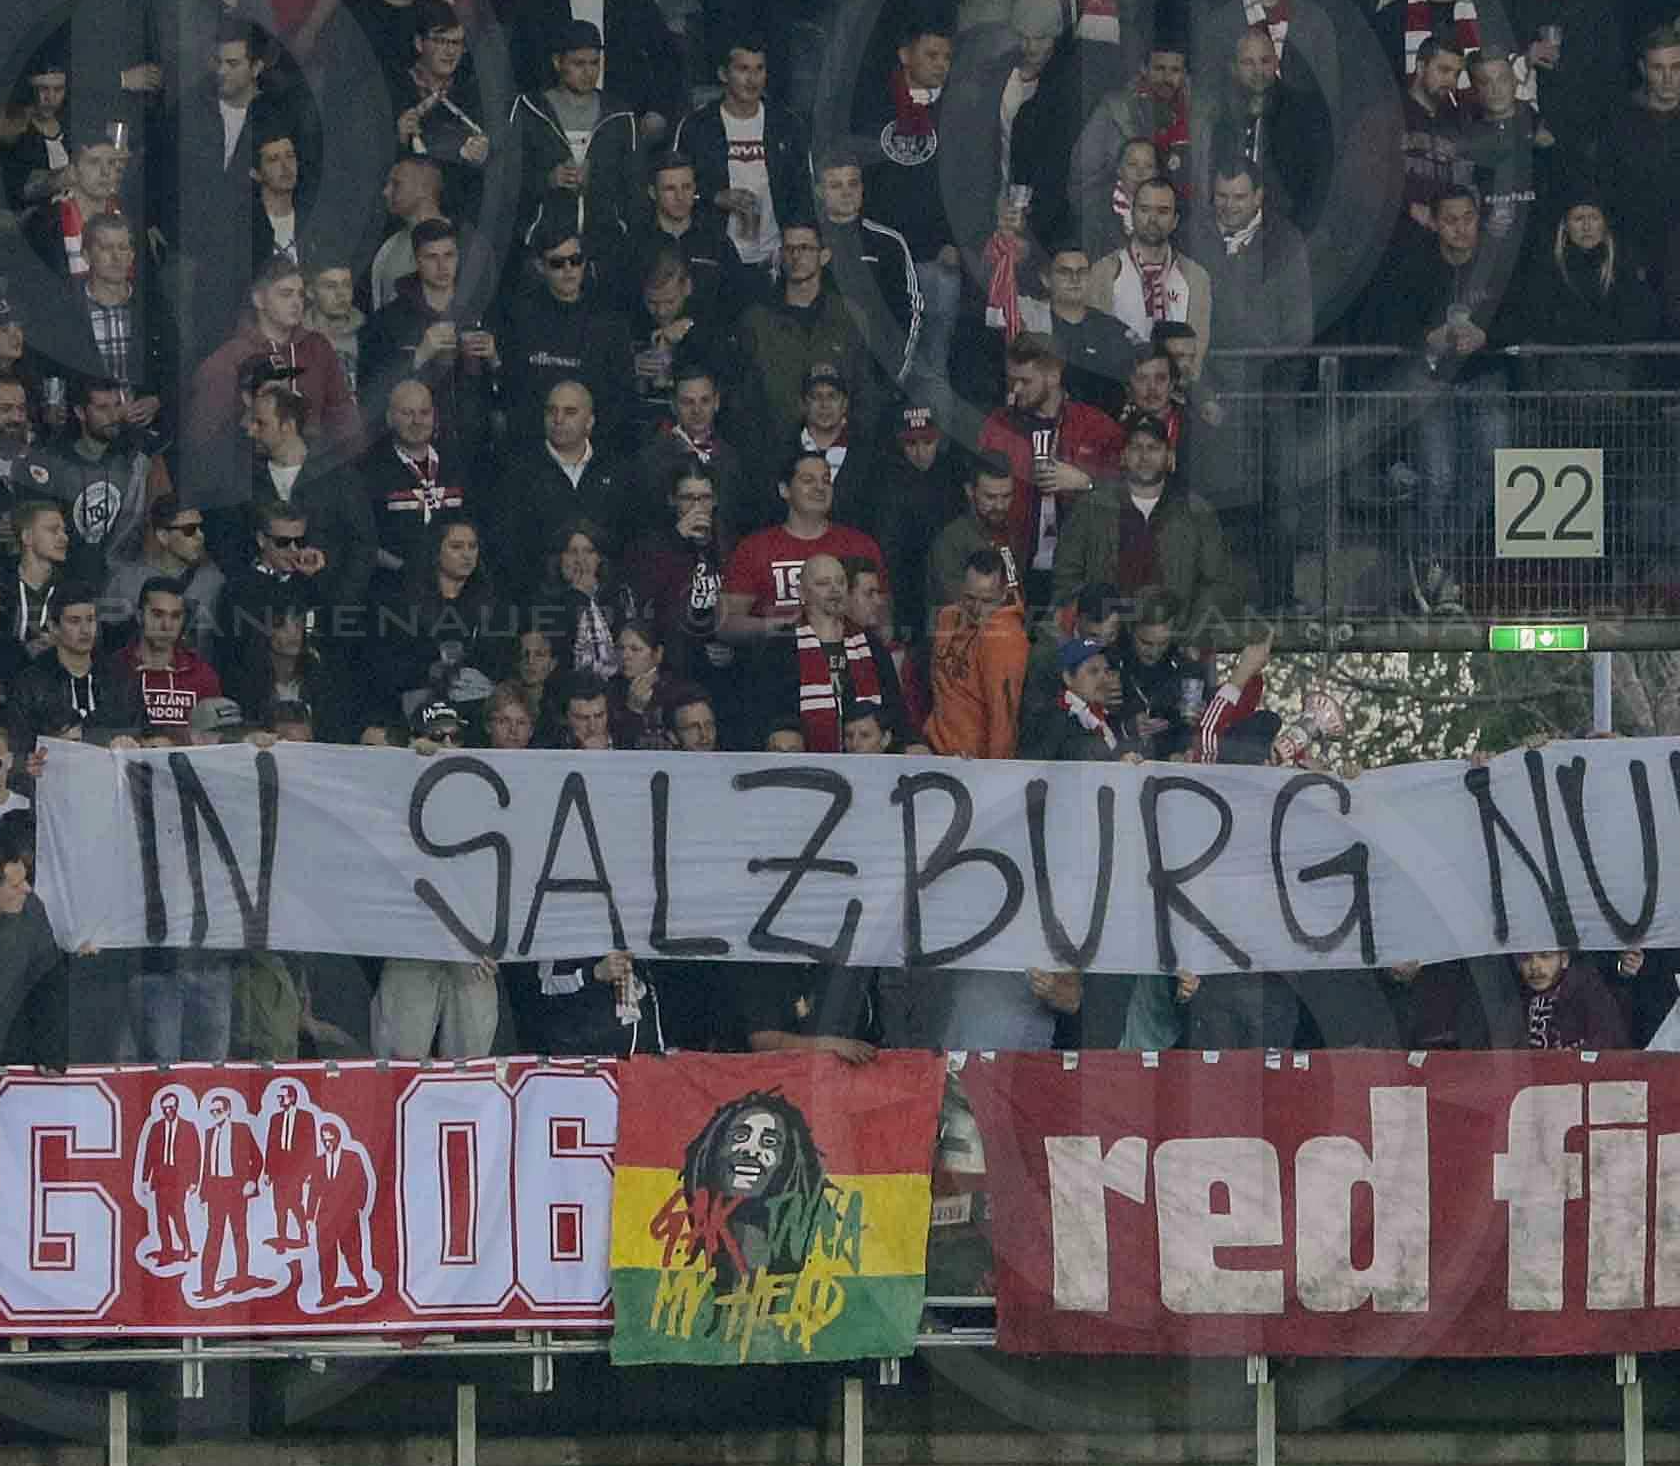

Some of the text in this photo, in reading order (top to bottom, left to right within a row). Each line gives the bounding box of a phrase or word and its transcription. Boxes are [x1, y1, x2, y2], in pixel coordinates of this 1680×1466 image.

[1505, 464, 1594, 541] 22
[154, 694, 193, 706] JEANS
[135, 749, 280, 950] IN
[406, 753, 1378, 972] SALZBURG
[395, 1069, 618, 1316] 06
[1044, 1085, 1431, 1315] red
